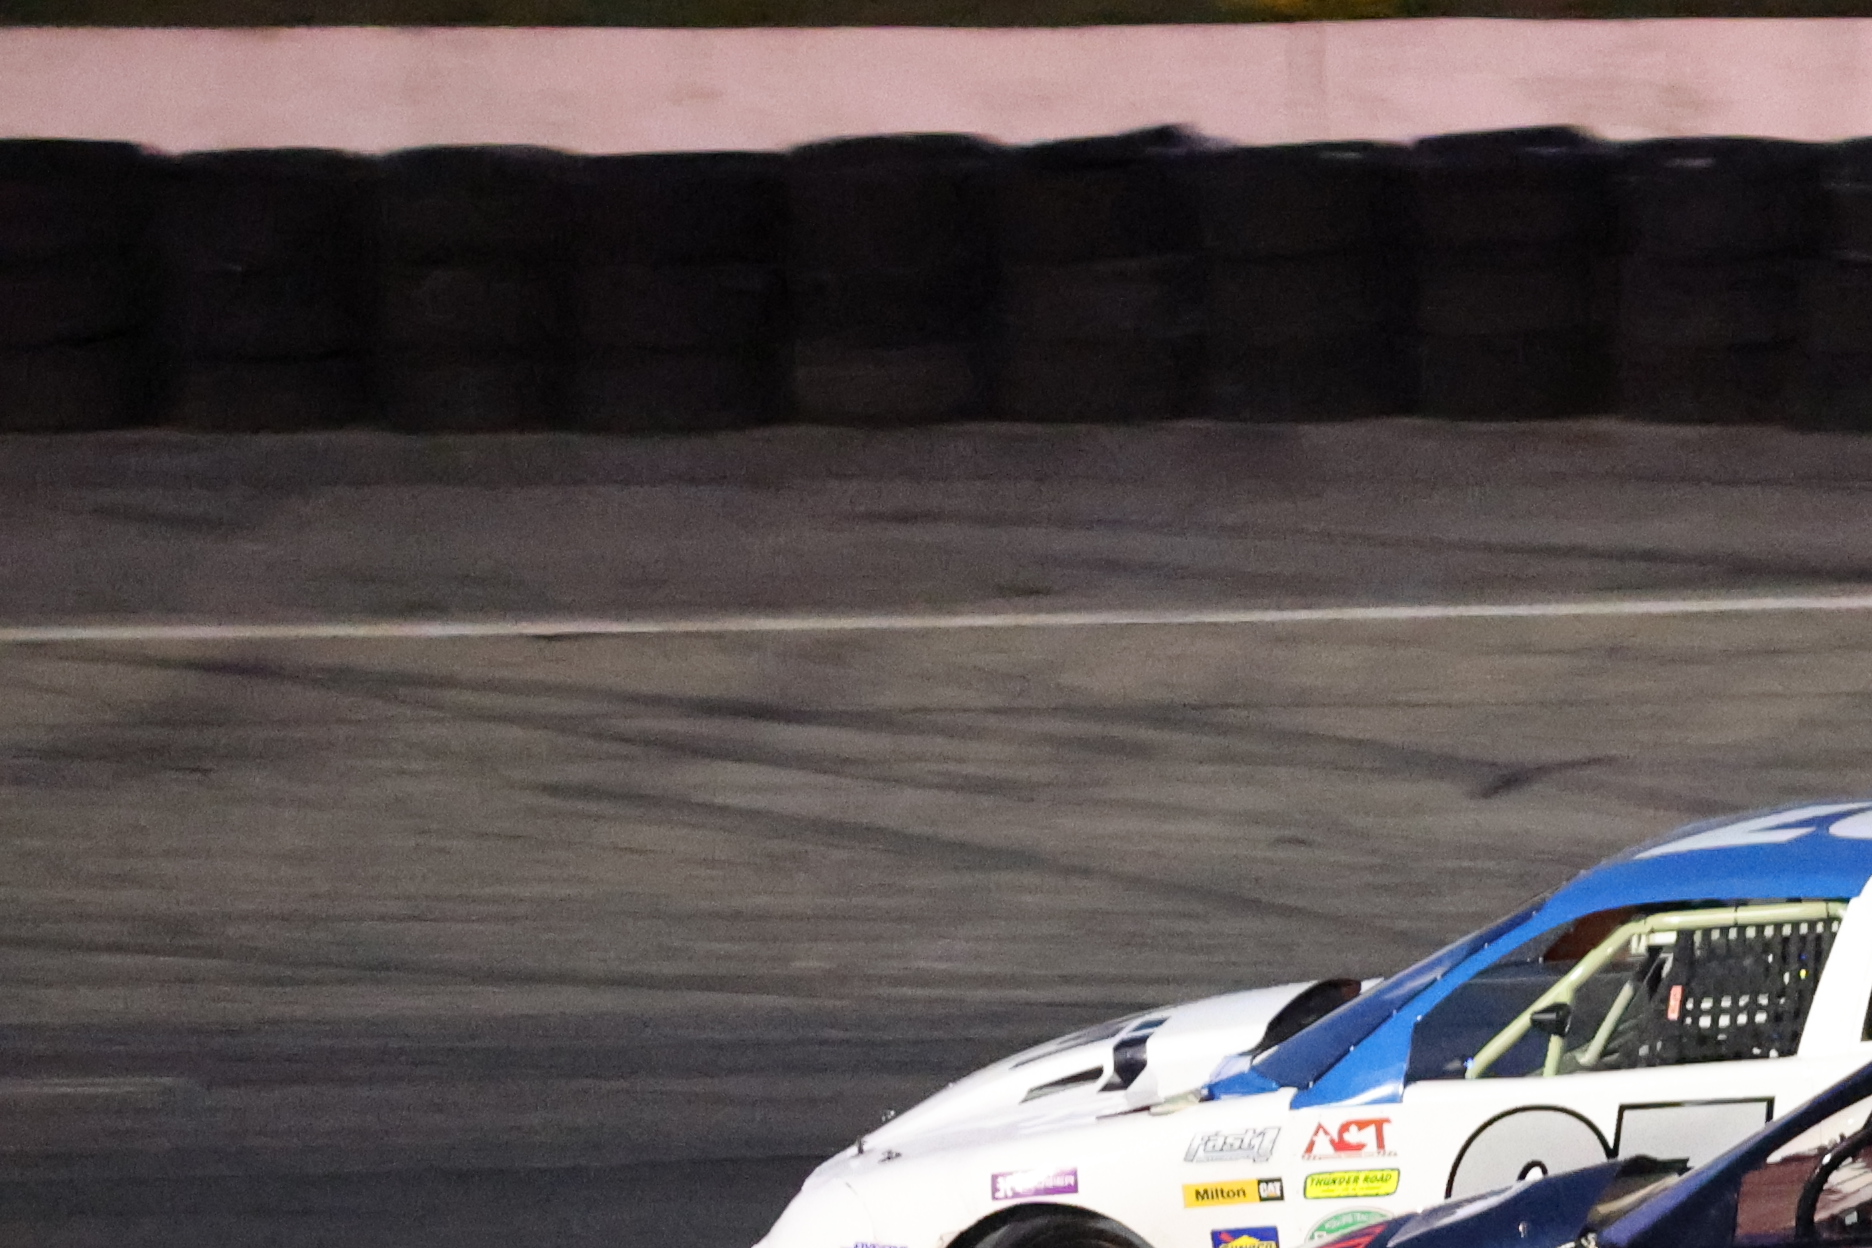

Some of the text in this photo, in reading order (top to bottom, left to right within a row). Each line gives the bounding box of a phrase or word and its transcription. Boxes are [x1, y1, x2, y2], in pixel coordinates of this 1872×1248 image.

[1303, 1117, 1392, 1154] ACT
[1310, 1173, 1392, 1187] THUNDER ROAD
[1195, 1186, 1247, 1202] Milton
